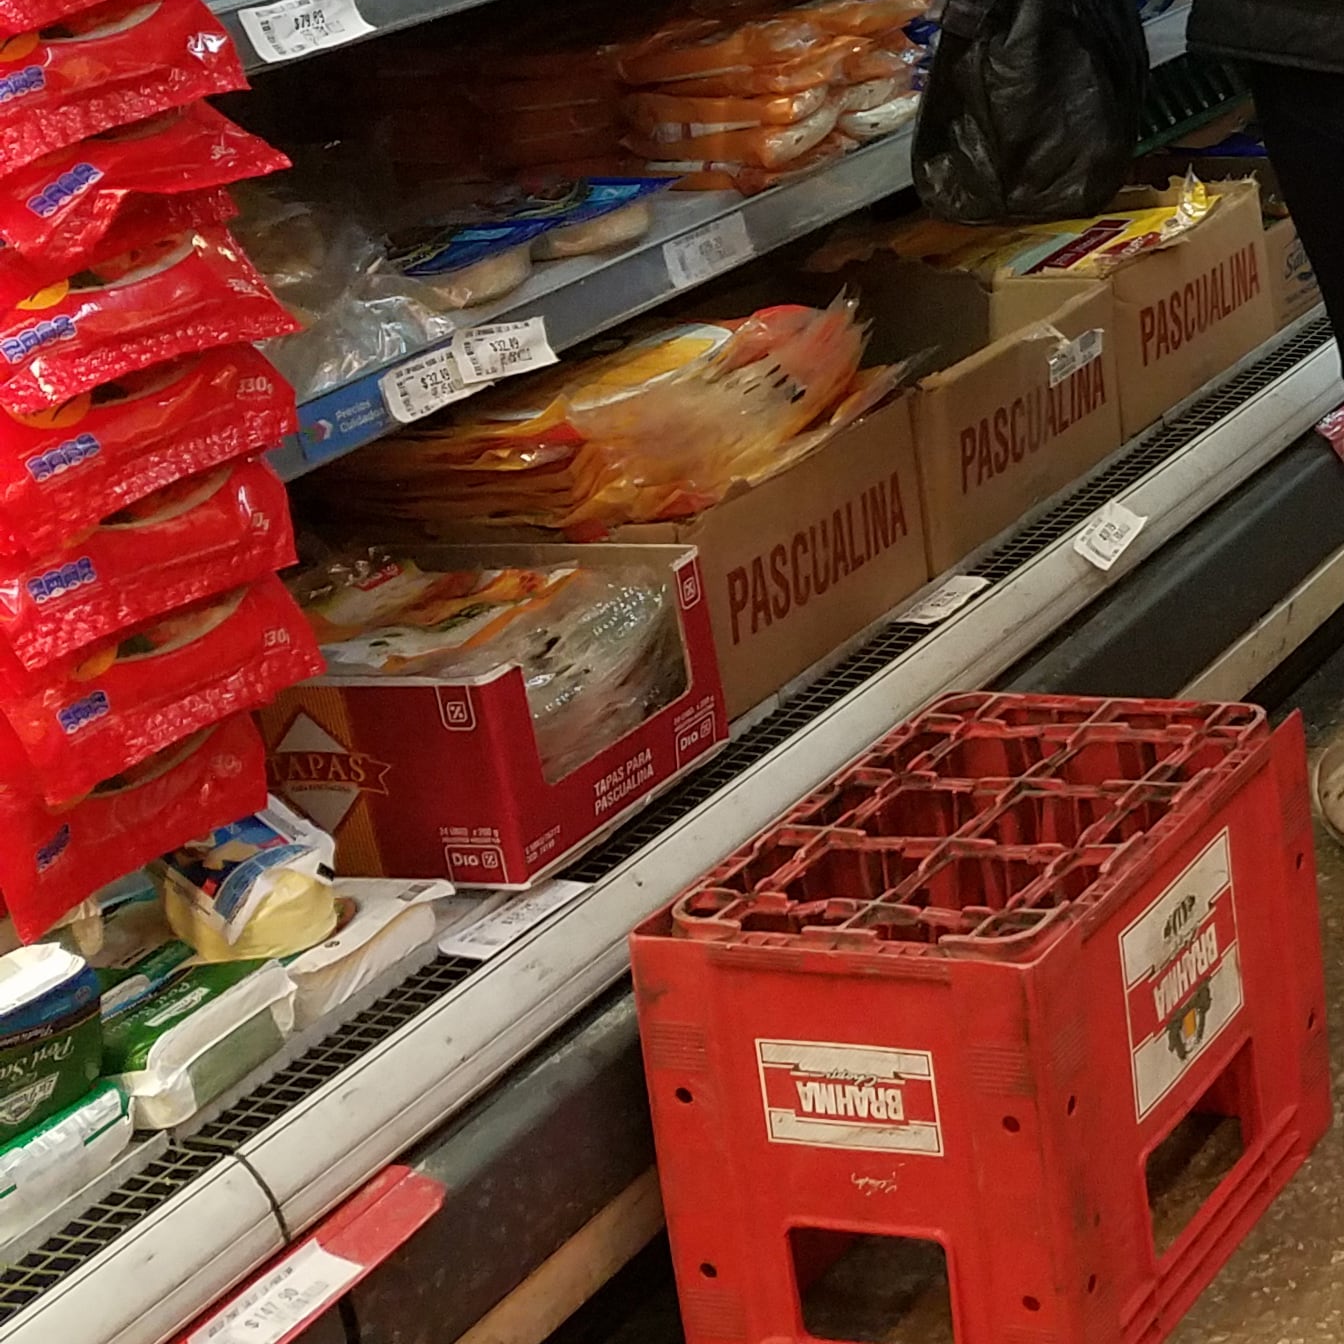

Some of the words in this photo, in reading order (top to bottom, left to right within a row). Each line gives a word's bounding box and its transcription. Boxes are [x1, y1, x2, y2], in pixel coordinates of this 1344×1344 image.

[1139, 241, 1261, 367] PASCUALINA
[339, 407, 386, 433] Cuidado
[959, 362, 1107, 495] PASCUALINA
[726, 471, 908, 646] PASCUALINA
[594, 766, 625, 797] TAPAS
[626, 747, 652, 775] PARA
[595, 763, 654, 816] PASCUALINA
[1153, 922, 1218, 1023] BRAHMA
[795, 1080, 905, 1121] BRAHMA
